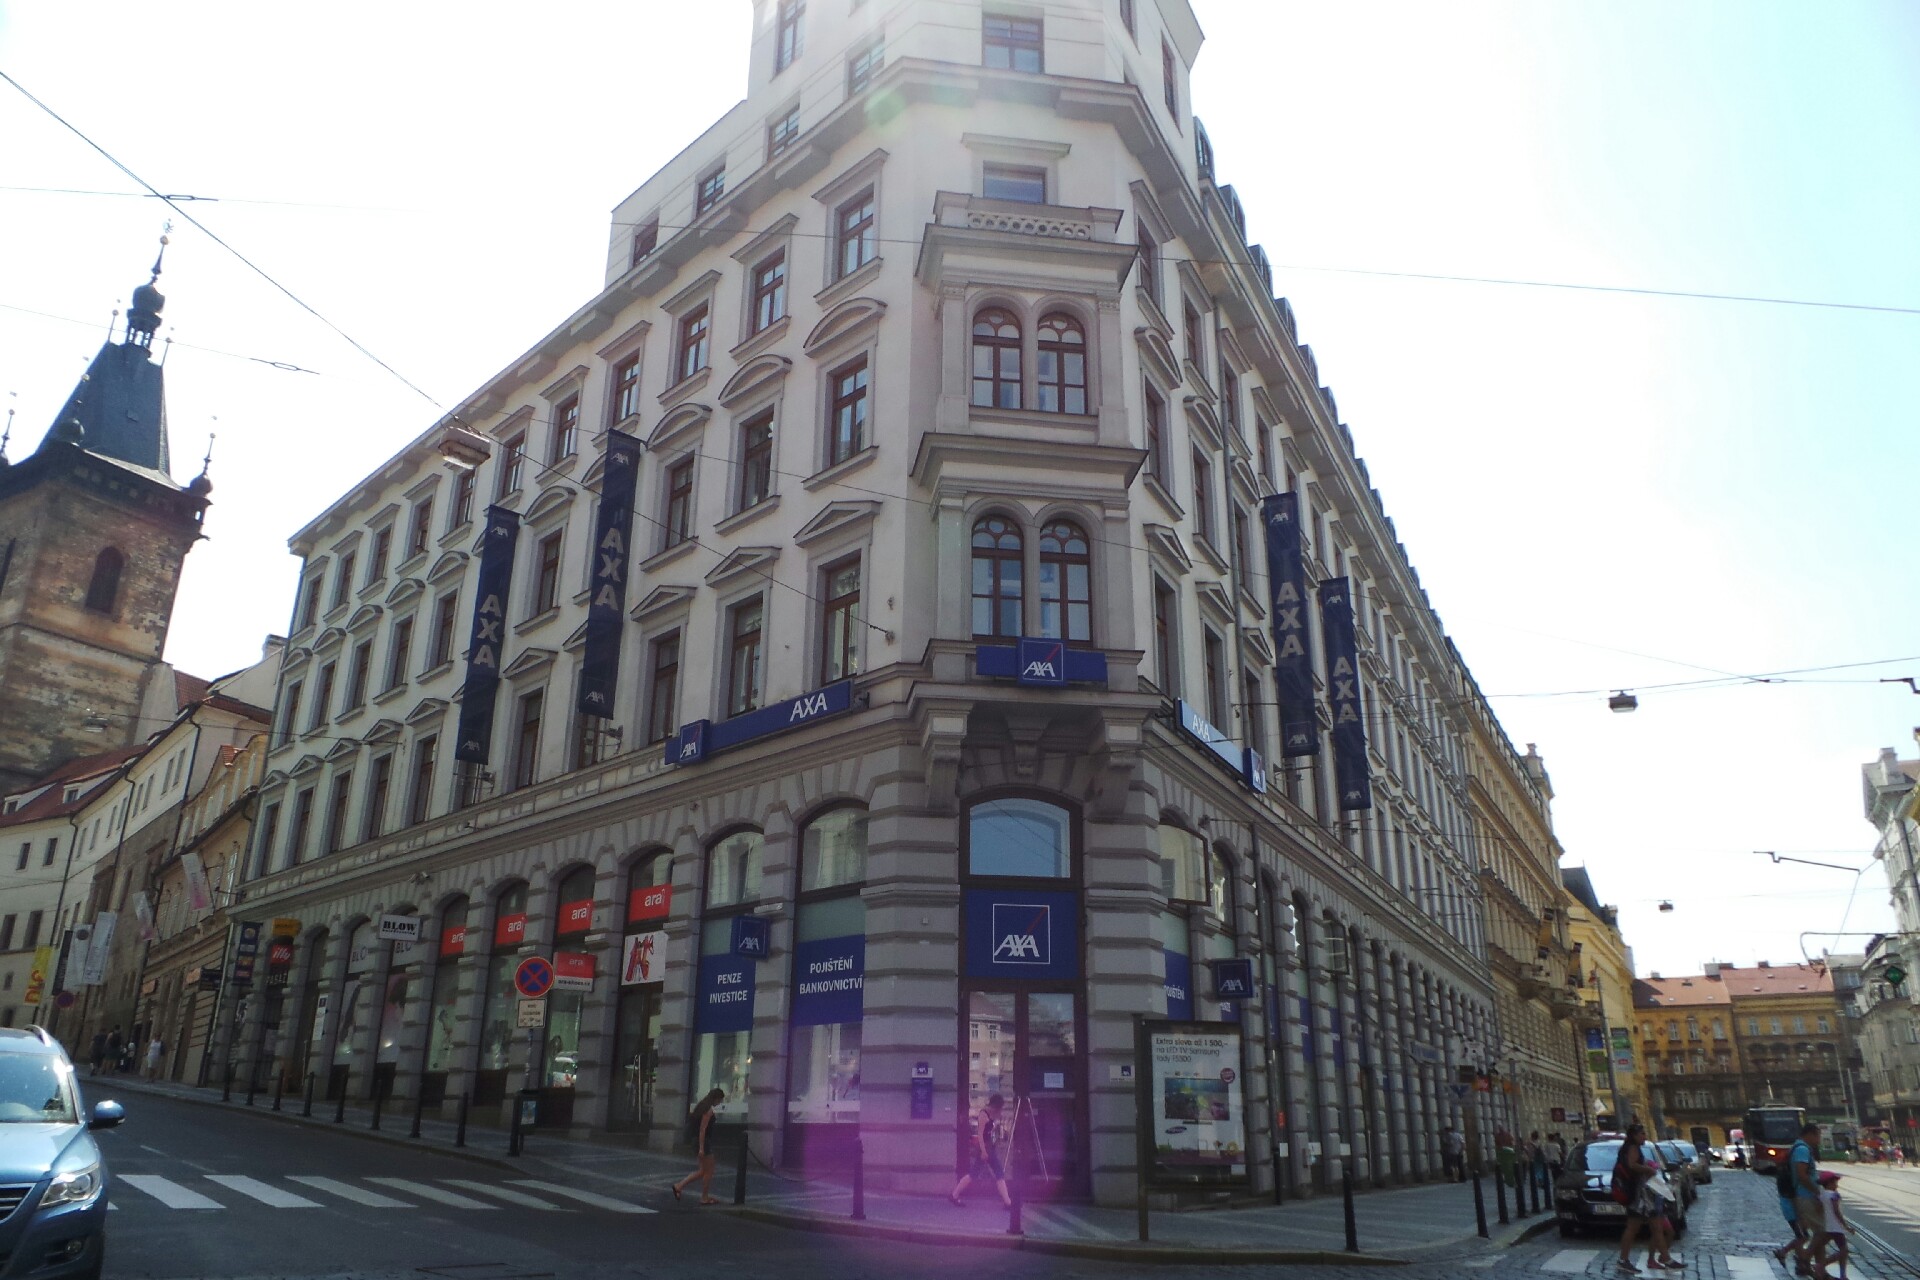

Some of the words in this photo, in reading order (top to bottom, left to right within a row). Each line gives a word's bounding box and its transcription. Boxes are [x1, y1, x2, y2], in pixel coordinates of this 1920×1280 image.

[594, 527, 625, 611] AXA
[1276, 582, 1305, 658] AXA
[473, 593, 502, 669] AXA
[1023, 661, 1056, 678] AXA
[1332, 656, 1360, 724] AXA
[789, 692, 828, 722] AXA
[1192, 714, 1211, 742] AXA
[680, 741, 697, 759] AXA
[644, 893, 662, 907] ara
[571, 907, 588, 920] ara
[383, 920, 417, 932] BLOW
[507, 920, 523, 932] ara
[451, 932, 464, 943] ara
[739, 936, 760, 951] AXA
[993, 934, 1040, 958] AXA
[272, 947, 291, 961] illy
[569, 958, 584, 966] ara
[810, 955, 854, 974] POJIŠTĚNÍ
[717, 972, 742, 985] PENZE
[799, 974, 864, 994] BANKOVNICTVÍ
[1219, 979, 1244, 991] AXA
[709, 989, 748, 1004] INVESTICE
[1189, 1047, 1220, 1057] Samsung
